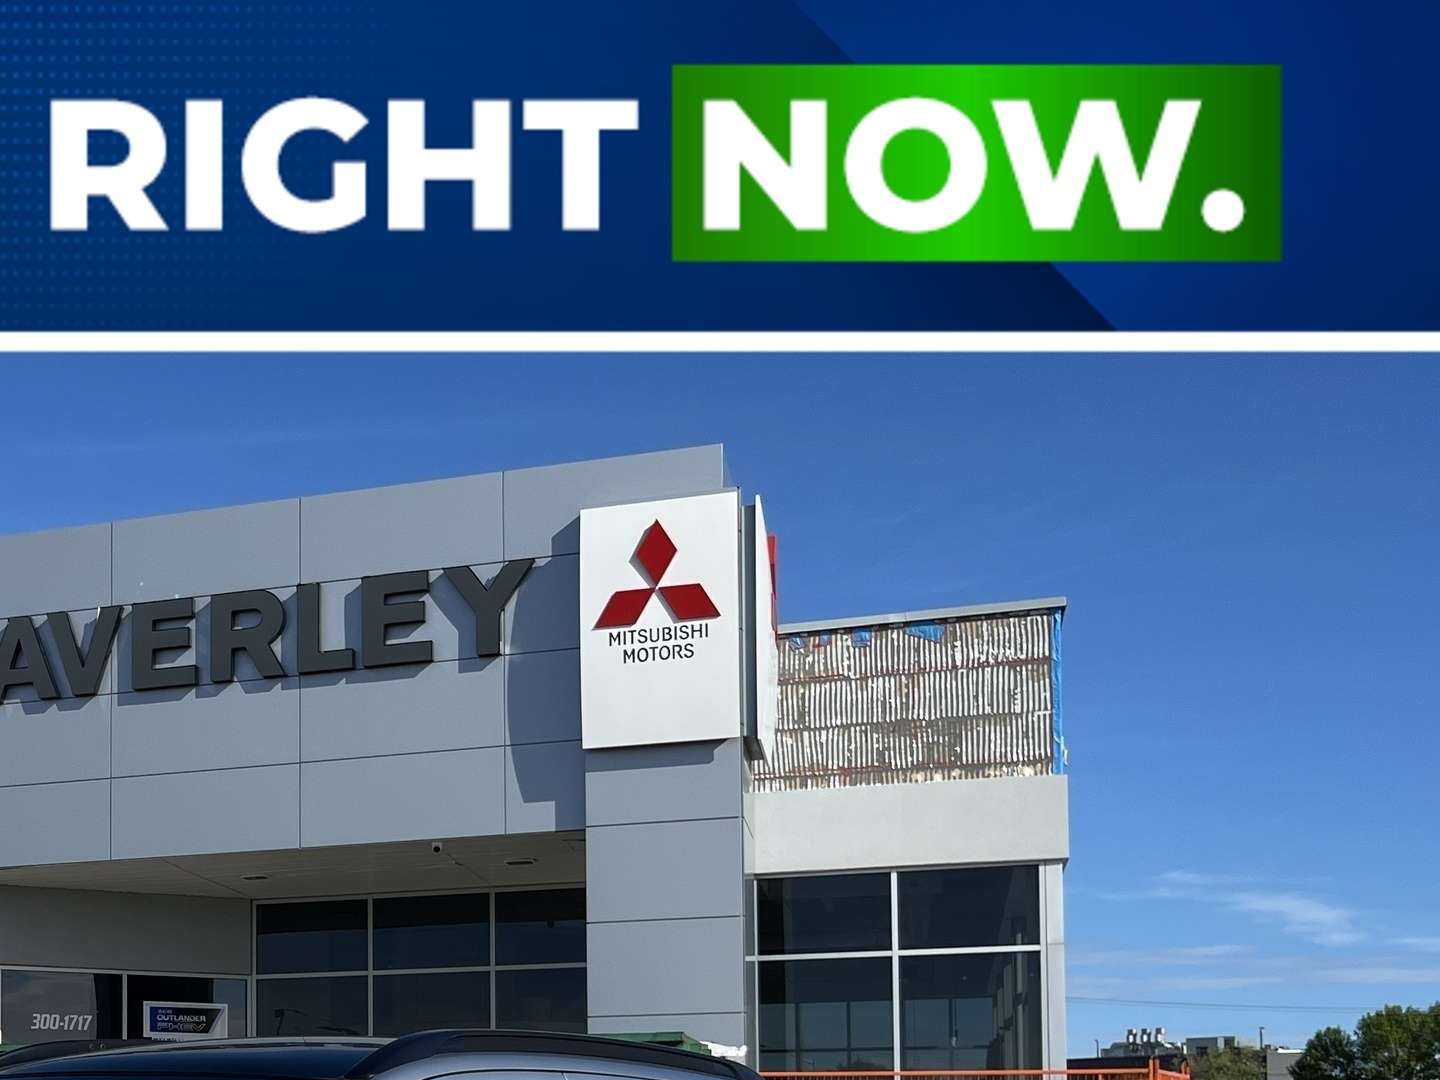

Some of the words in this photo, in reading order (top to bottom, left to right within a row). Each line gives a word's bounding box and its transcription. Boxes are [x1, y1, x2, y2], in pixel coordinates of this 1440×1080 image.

[608, 623, 709, 647] MITSUBISHI
[623, 644, 695, 664] MOTORS
[30, 1013, 93, 1031] 300-1717
